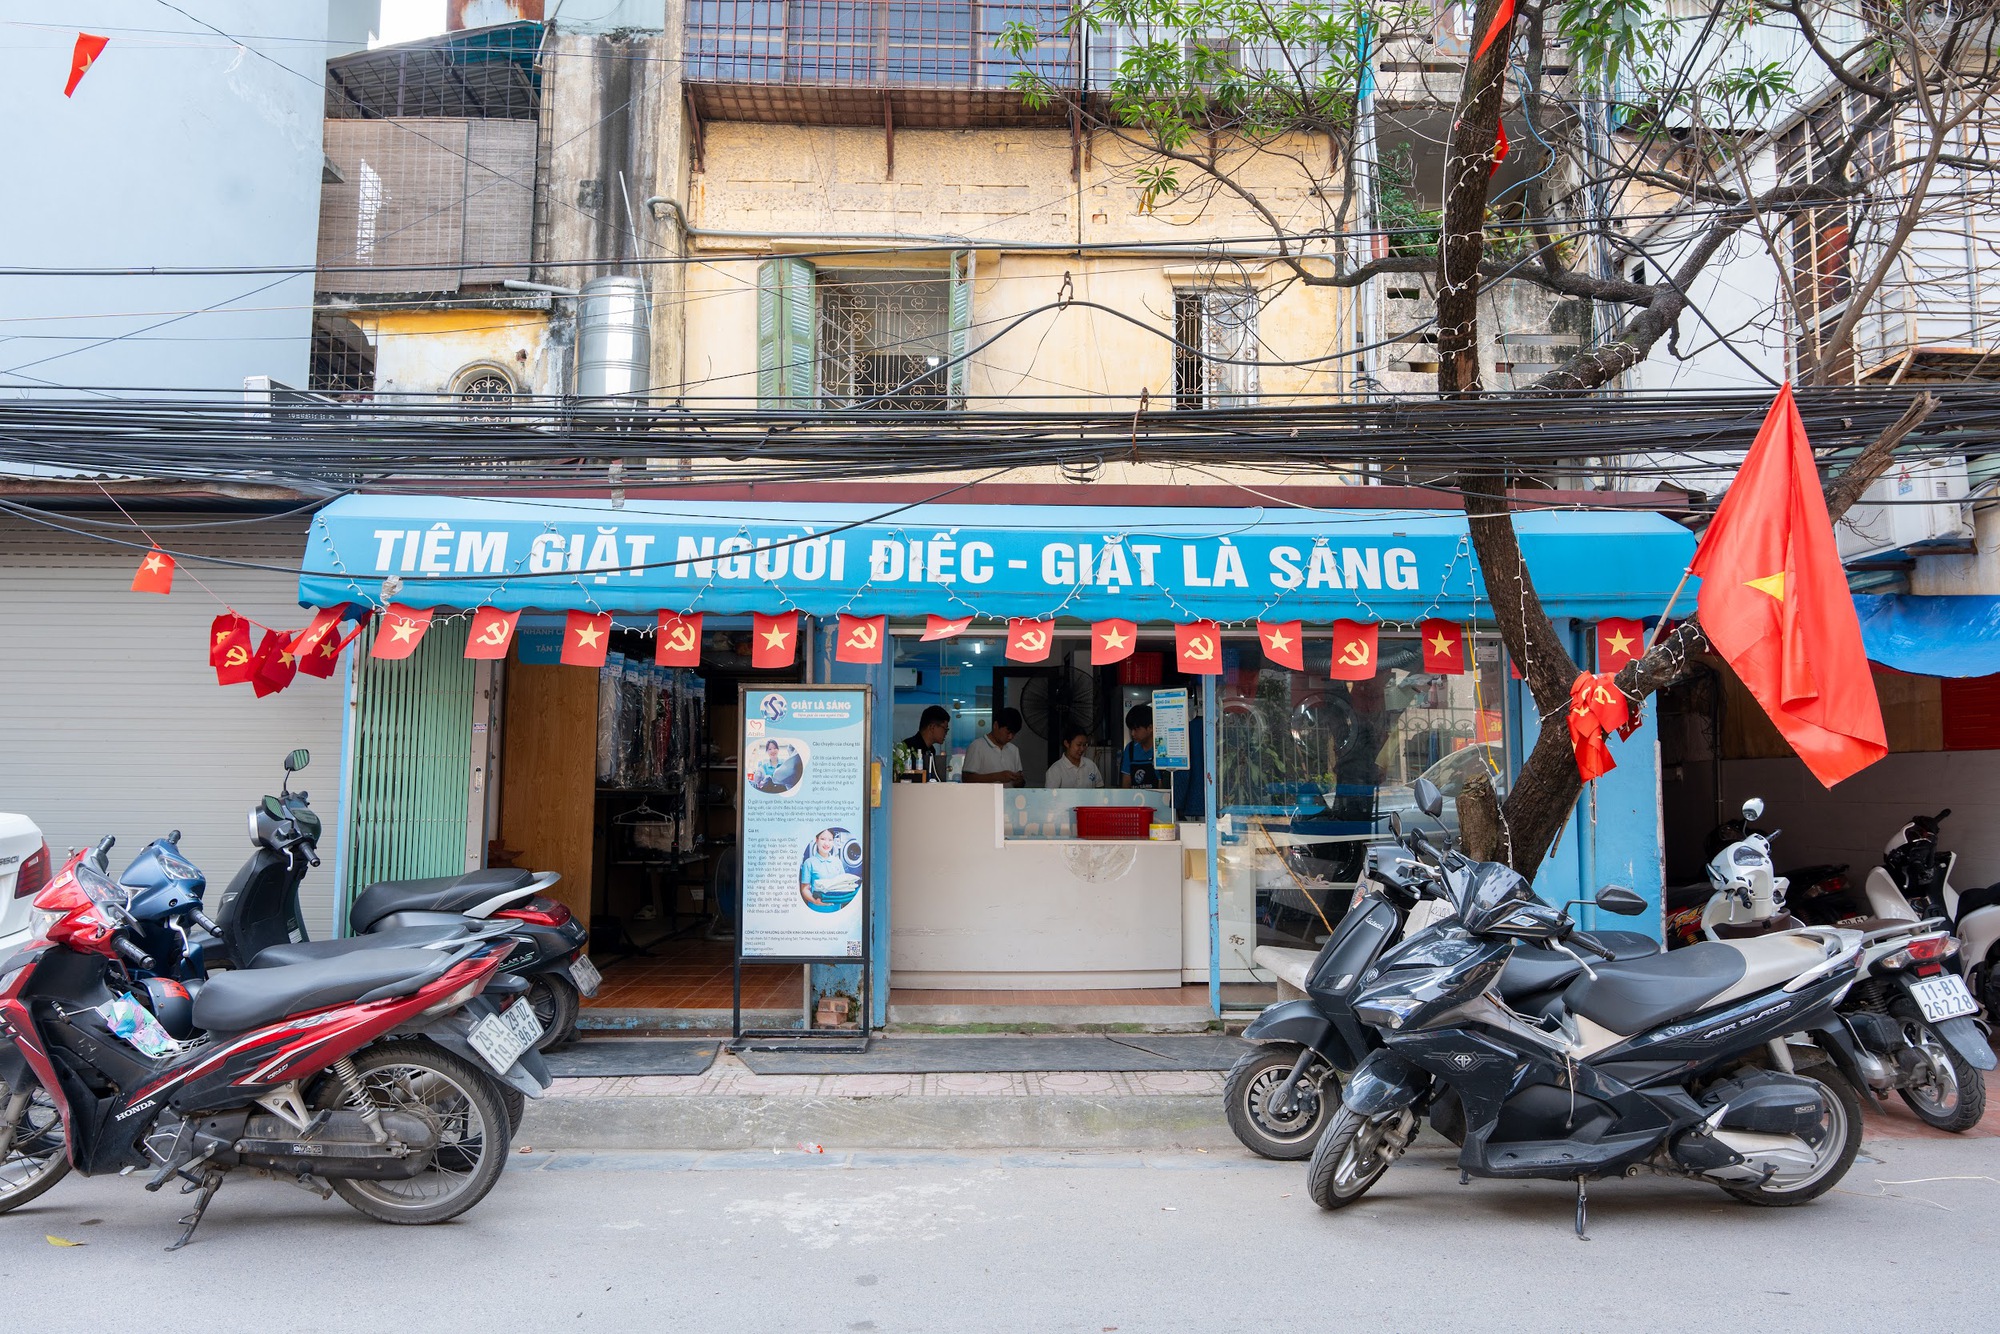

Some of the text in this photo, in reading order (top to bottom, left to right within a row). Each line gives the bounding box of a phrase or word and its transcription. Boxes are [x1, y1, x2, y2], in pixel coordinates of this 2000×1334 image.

[374, 522, 509, 577] TIỆM
[529, 526, 655, 583] GIẶT
[676, 526, 846, 581] NGƯỜI
[868, 528, 994, 584] ĐIẾC
[1008, 560, 1027, 569] -
[1041, 534, 1161, 594] GIẶT
[1183, 537, 1249, 587] LÀ
[1920, 979, 1959, 1001] 11-B1
[1924, 994, 1974, 1020] 262.28
[489, 1032, 523, 1070] 119.35
[115, 1100, 157, 1122] HONDA
